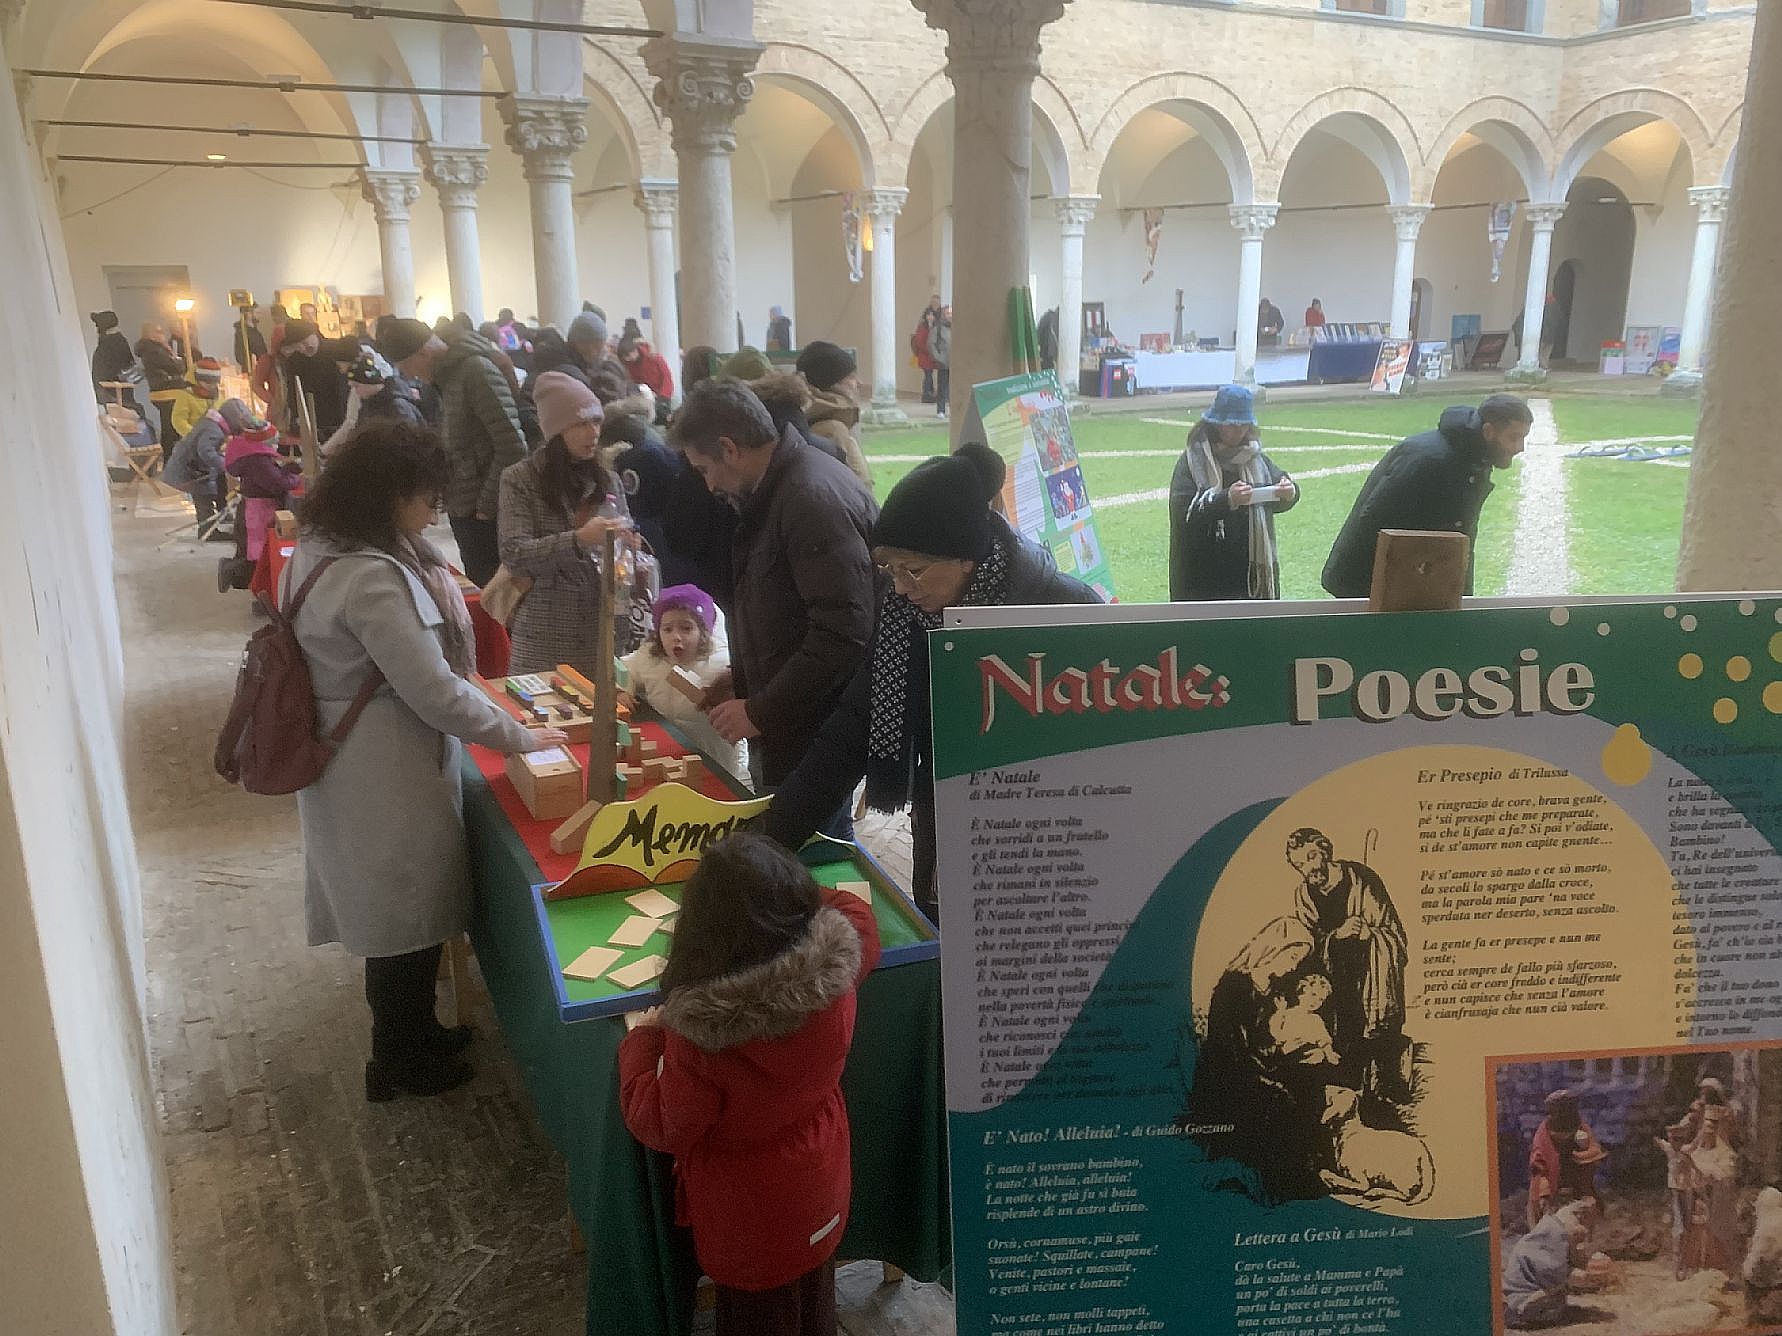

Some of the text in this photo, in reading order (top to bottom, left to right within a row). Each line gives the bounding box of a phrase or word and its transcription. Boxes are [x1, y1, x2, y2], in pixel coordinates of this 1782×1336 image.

[977, 646, 1595, 735] Natale: Poesie
[991, 770, 1041, 785] Natale
[1418, 768, 1568, 784] Er Presepio di Trilussa
[969, 785, 1132, 800] di Madre Teresa di Calcutta
[1418, 800, 1433, 811] Ve
[1437, 798, 1488, 812] ringrazio
[1491, 798, 1504, 808] de
[1538, 796, 1569, 805] brava
[983, 818, 1021, 830] Natale
[1025, 817, 1051, 830] ogni
[1055, 816, 1083, 827] volta
[1455, 813, 1496, 827] presepi
[1499, 812, 1519, 821] che
[1522, 812, 1539, 820] me
[593, 805, 749, 866] Memo
[971, 834, 990, 845] che
[1037, 834, 1044, 843] a
[1048, 833, 1062, 842] un
[1064, 829, 1109, 844] fratello
[1420, 829, 1436, 839] ma
[1440, 828, 1459, 837] che
[1462, 827, 1470, 837] li
[1472, 826, 1494, 839] fate
[1507, 824, 1525, 837] fa?
[1529, 823, 1540, 834] Si
[1544, 823, 1562, 835] poi
[1420, 843, 1429, 853] si
[1432, 843, 1445, 852] de
[1501, 840, 1522, 849] non
[1526, 837, 1560, 850] capite
[982, 849, 996, 863] gli
[1000, 849, 1028, 860] tendi
[1032, 848, 1044, 859] la
[985, 864, 1023, 875] Natale
[1027, 863, 1052, 874] ogni
[1057, 862, 1085, 872] volta
[1507, 868, 1530, 877] nato
[973, 879, 992, 890] che
[997, 878, 1036, 890] rimani
[1040, 876, 1051, 887] in
[1438, 882, 1469, 894] secoli
[1474, 881, 1483, 892] lo
[1487, 881, 1525, 894] spargo
[1527, 878, 1555, 890] dalla
[1421, 899, 1438, 909] ma
[1443, 897, 1452, 908] la
[1456, 894, 1492, 909] parola
[1496, 894, 1516, 905] mia
[1520, 894, 1544, 906] pare
[1571, 892, 1595, 901] voce
[1474, 910, 1492, 919] ner
[1543, 906, 1573, 916] senza
[1423, 939, 1438, 950] La
[1441, 939, 1470, 950] gente
[1474, 936, 1486, 950] fa
[1489, 938, 1501, 946] er
[1504, 934, 1546, 948] presepe
[1559, 934, 1581, 943] nun
[1585, 933, 1601, 942] me
[1424, 968, 1453, 978] cerca
[1457, 966, 1497, 980] sempre
[1501, 963, 1514, 974] de
[1470, 980, 1482, 989] er
[1484, 979, 1509, 988] core
[1509, 975, 1546, 989] freddo
[1549, 976, 1555, 985] e
[1558, 973, 1622, 987] indifferente
[1502, 1004, 1521, 1015] che
[1525, 1005, 1547, 1013] nun
[1006, 1128, 1050, 1144] Nato!
[1054, 1125, 1121, 1142] Alleluia!
[1132, 1126, 1143, 1137] di
[1146, 1125, 1181, 1137] Guido
[1185, 1123, 1234, 1135] Gozzano
[998, 1163, 1023, 1175] nato
[1027, 1160, 1035, 1173] il
[1039, 1161, 1085, 1172] sovrano
[996, 1177, 1025, 1189] nato!
[986, 1194, 1002, 1205] La
[1006, 1193, 1035, 1205] notte
[1038, 1191, 1056, 1204] che
[1082, 1190, 1095, 1202] fu
[1112, 1188, 1137, 1198] buia
[986, 1207, 1040, 1222] risplende
[1043, 1205, 1054, 1216] di
[1058, 1206, 1073, 1216] un
[1077, 1204, 1105, 1214] astro
[1235, 1226, 1414, 1246] Lettera a Gesù di Mario Lodi
[1235, 1261, 1263, 1271] Caro
[1253, 1273, 1263, 1283] la
[1268, 1272, 1300, 1283] salute
[1304, 1273, 1311, 1281] a
[1314, 1270, 1361, 1281] Mamma
